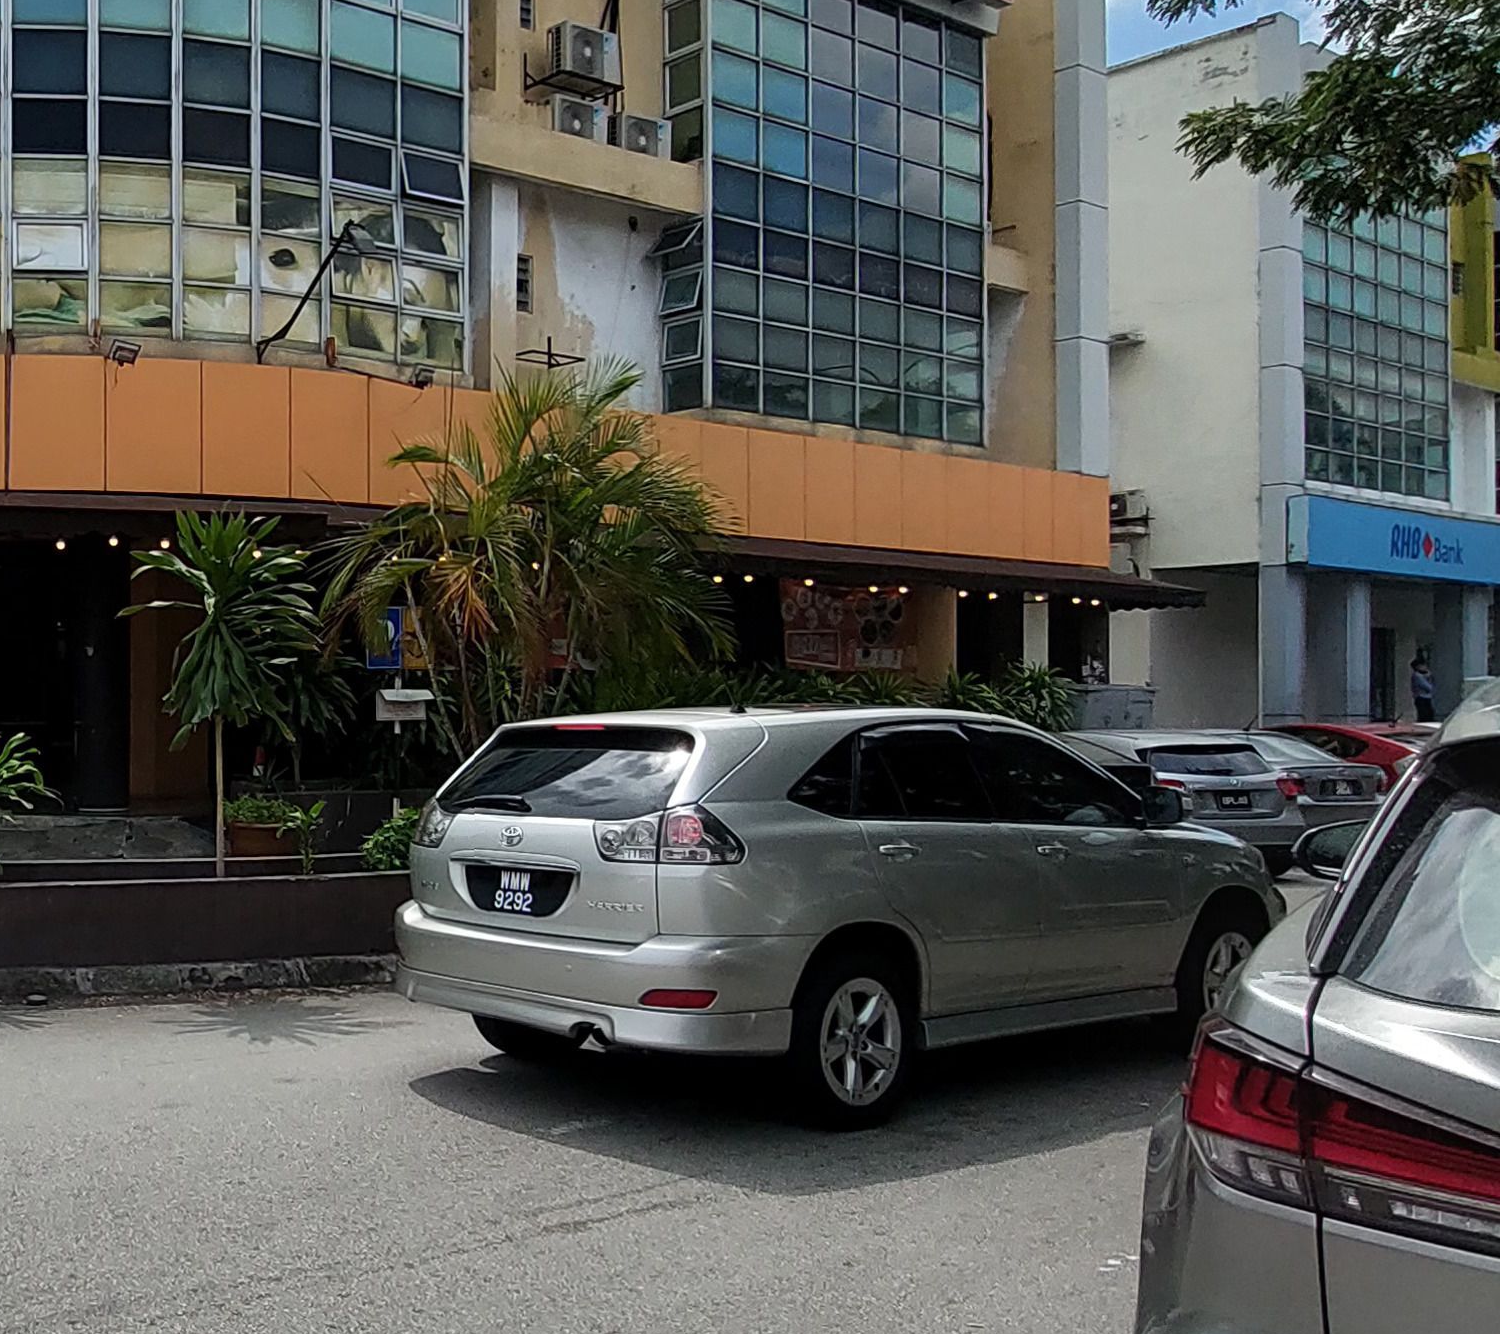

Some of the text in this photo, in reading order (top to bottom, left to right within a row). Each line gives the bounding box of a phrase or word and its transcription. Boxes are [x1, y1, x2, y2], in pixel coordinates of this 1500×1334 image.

[1390, 523, 1464, 565] RHB Bank
[501, 870, 531, 892] WMW
[494, 890, 533, 913] 9292
